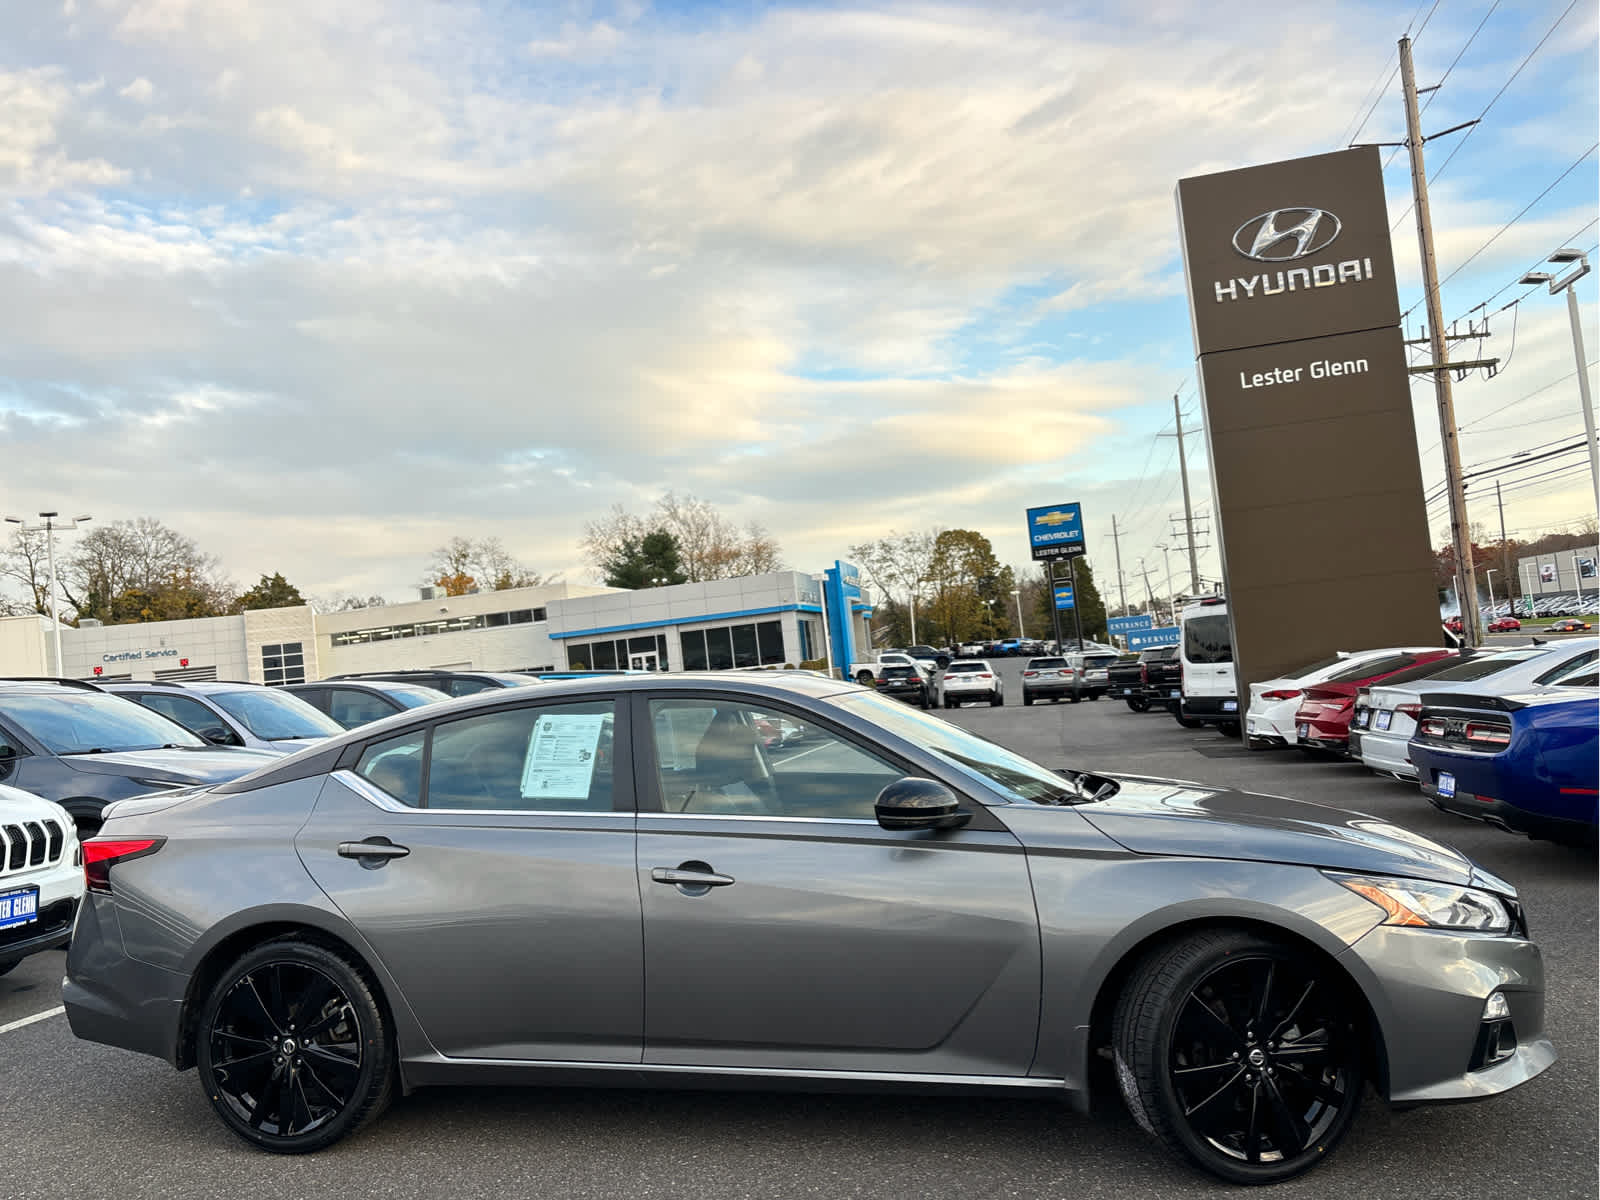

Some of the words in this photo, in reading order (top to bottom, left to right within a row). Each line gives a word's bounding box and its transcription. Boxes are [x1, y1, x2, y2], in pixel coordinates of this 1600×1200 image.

[1214, 258, 1374, 303] HYUNDAI
[1240, 368, 1303, 389] Lester
[1310, 359, 1369, 379] Glenn
[1034, 530, 1079, 542] CHEVROLET
[1035, 548, 1059, 556] LESTER
[1060, 546, 1081, 554] GLENN
[1110, 620, 1149, 630] ENTRANCE
[1142, 634, 1180, 642] SERVICE
[103, 651, 142, 662] Certified
[145, 649, 178, 658] Service
[14, 897, 36, 916] GLENN
